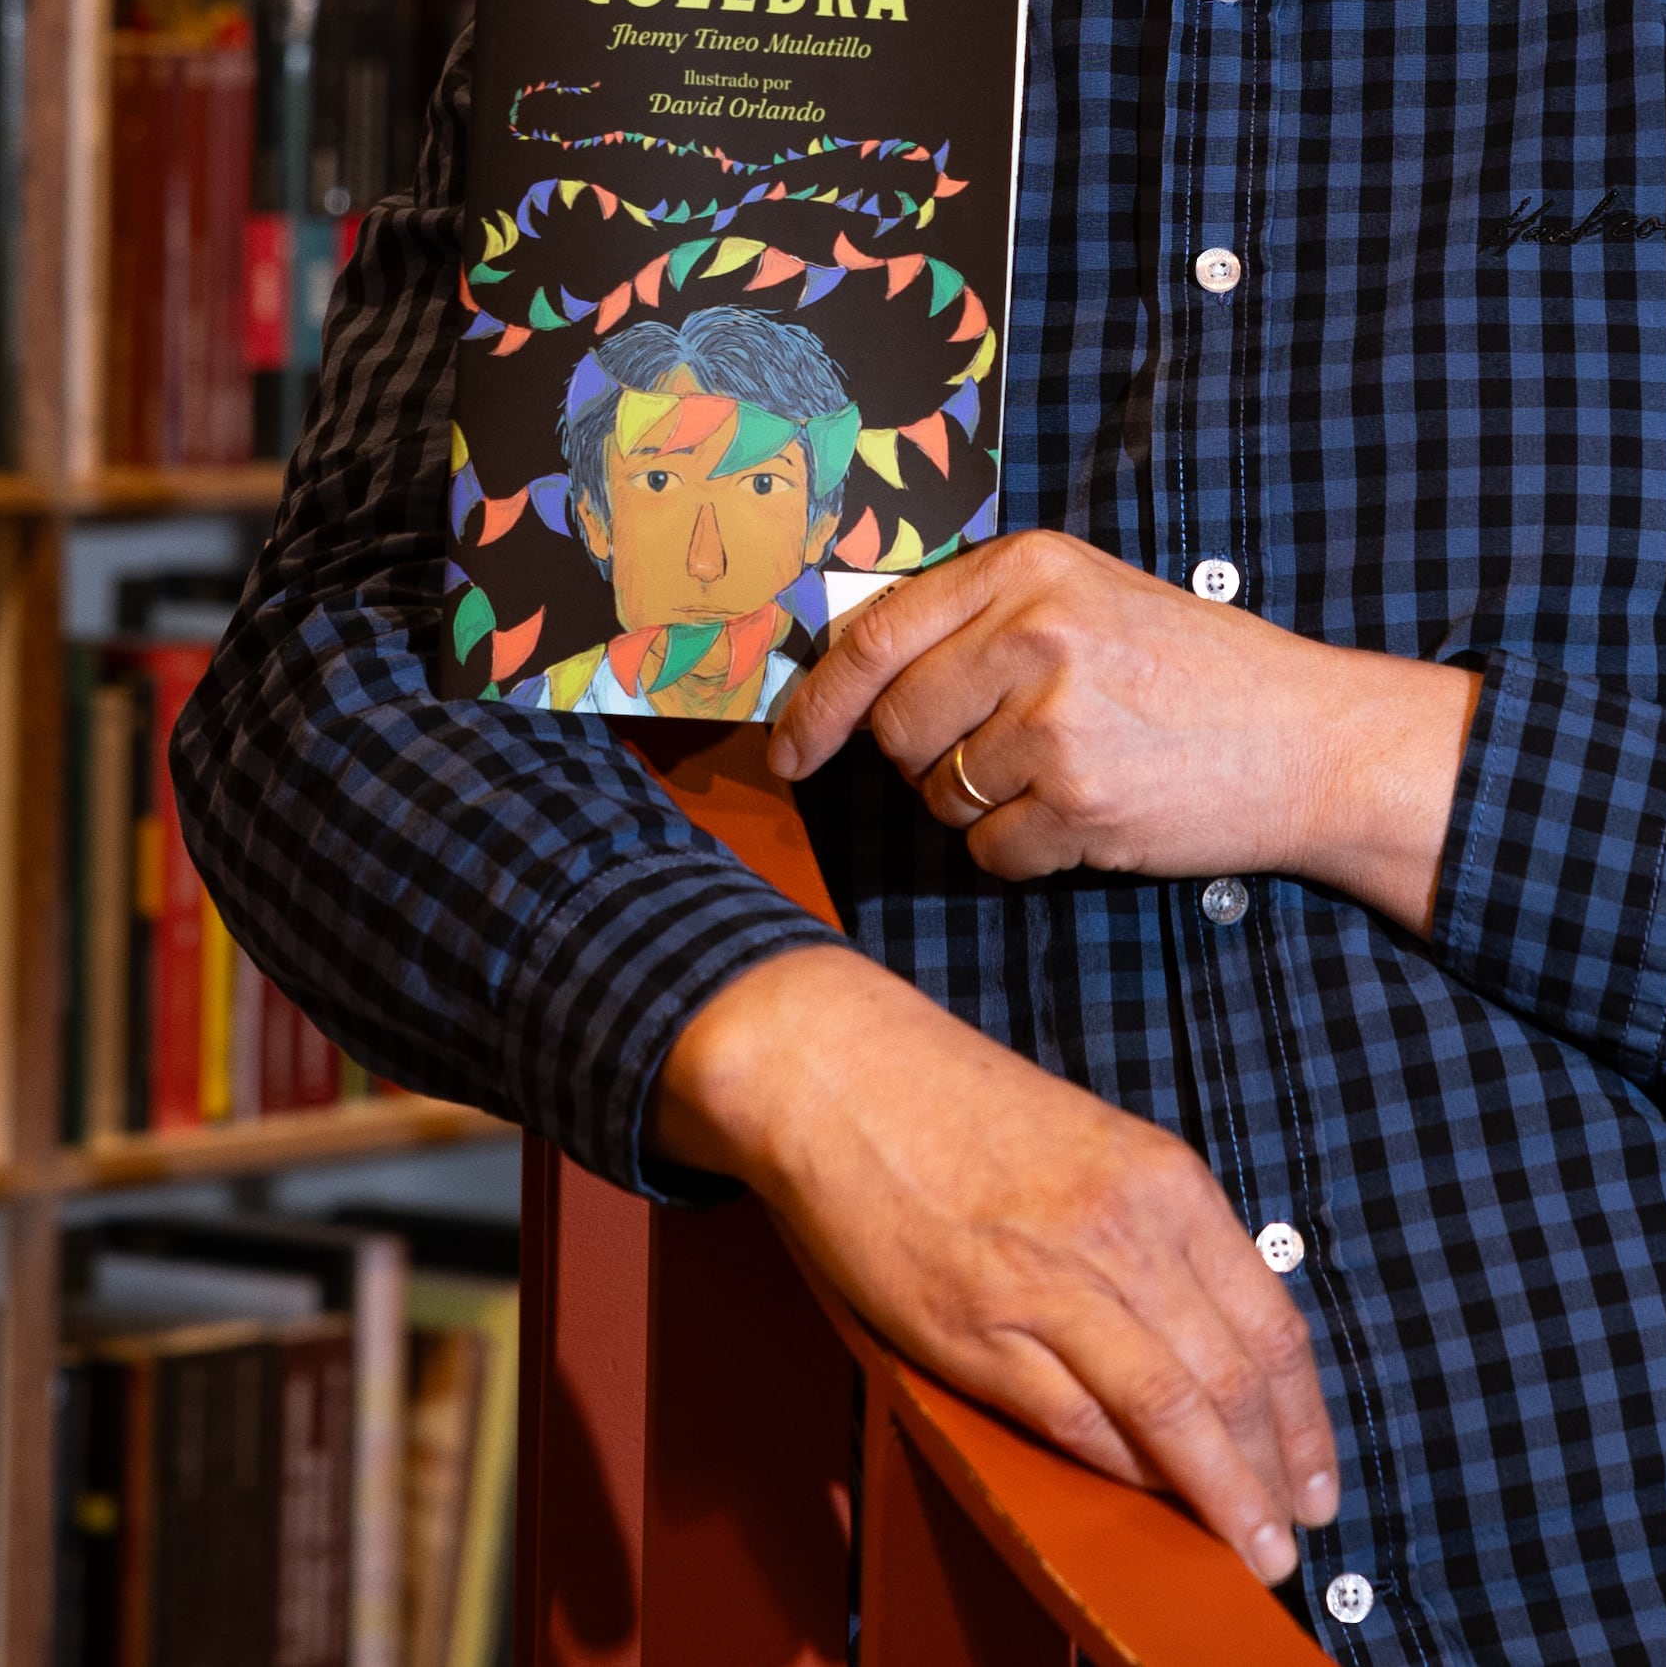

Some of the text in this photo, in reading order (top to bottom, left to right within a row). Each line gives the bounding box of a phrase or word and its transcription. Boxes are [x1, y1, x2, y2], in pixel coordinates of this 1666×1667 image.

[606, 23, 872, 59] Jhemy Tineo Mulatillo
[683, 69, 792, 94] Ilustrado por
[649, 93, 826, 123] David Orlando
